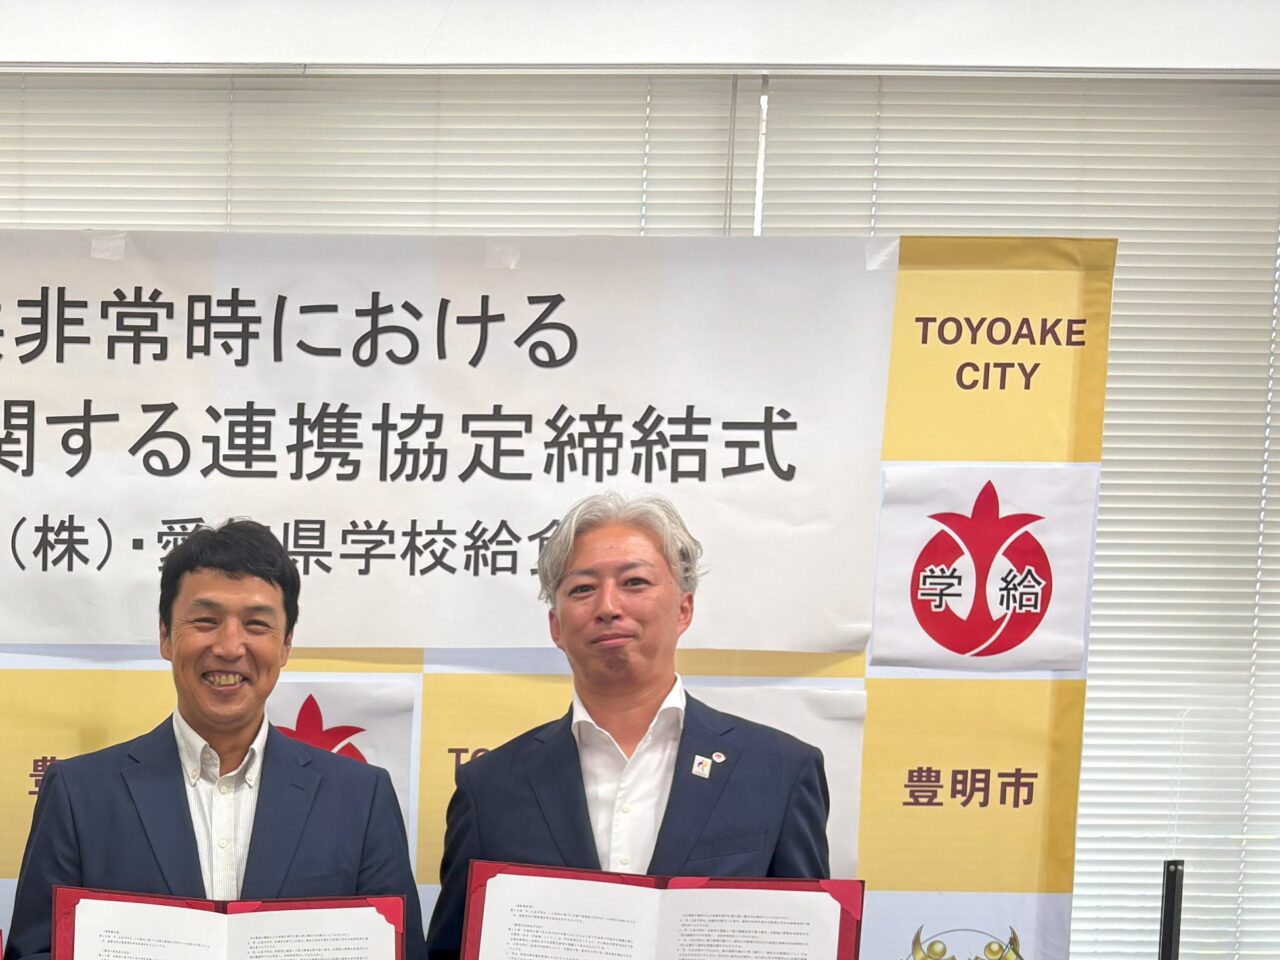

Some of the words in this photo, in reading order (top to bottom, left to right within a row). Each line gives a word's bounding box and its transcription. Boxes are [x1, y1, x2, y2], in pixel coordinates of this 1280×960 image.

[914, 316, 1088, 348] TOYOAKE
[954, 361, 1041, 392] CITY
[918, 567, 964, 609] 学
[997, 567, 1043, 612] 給
[902, 767, 1039, 810] 豊明市
